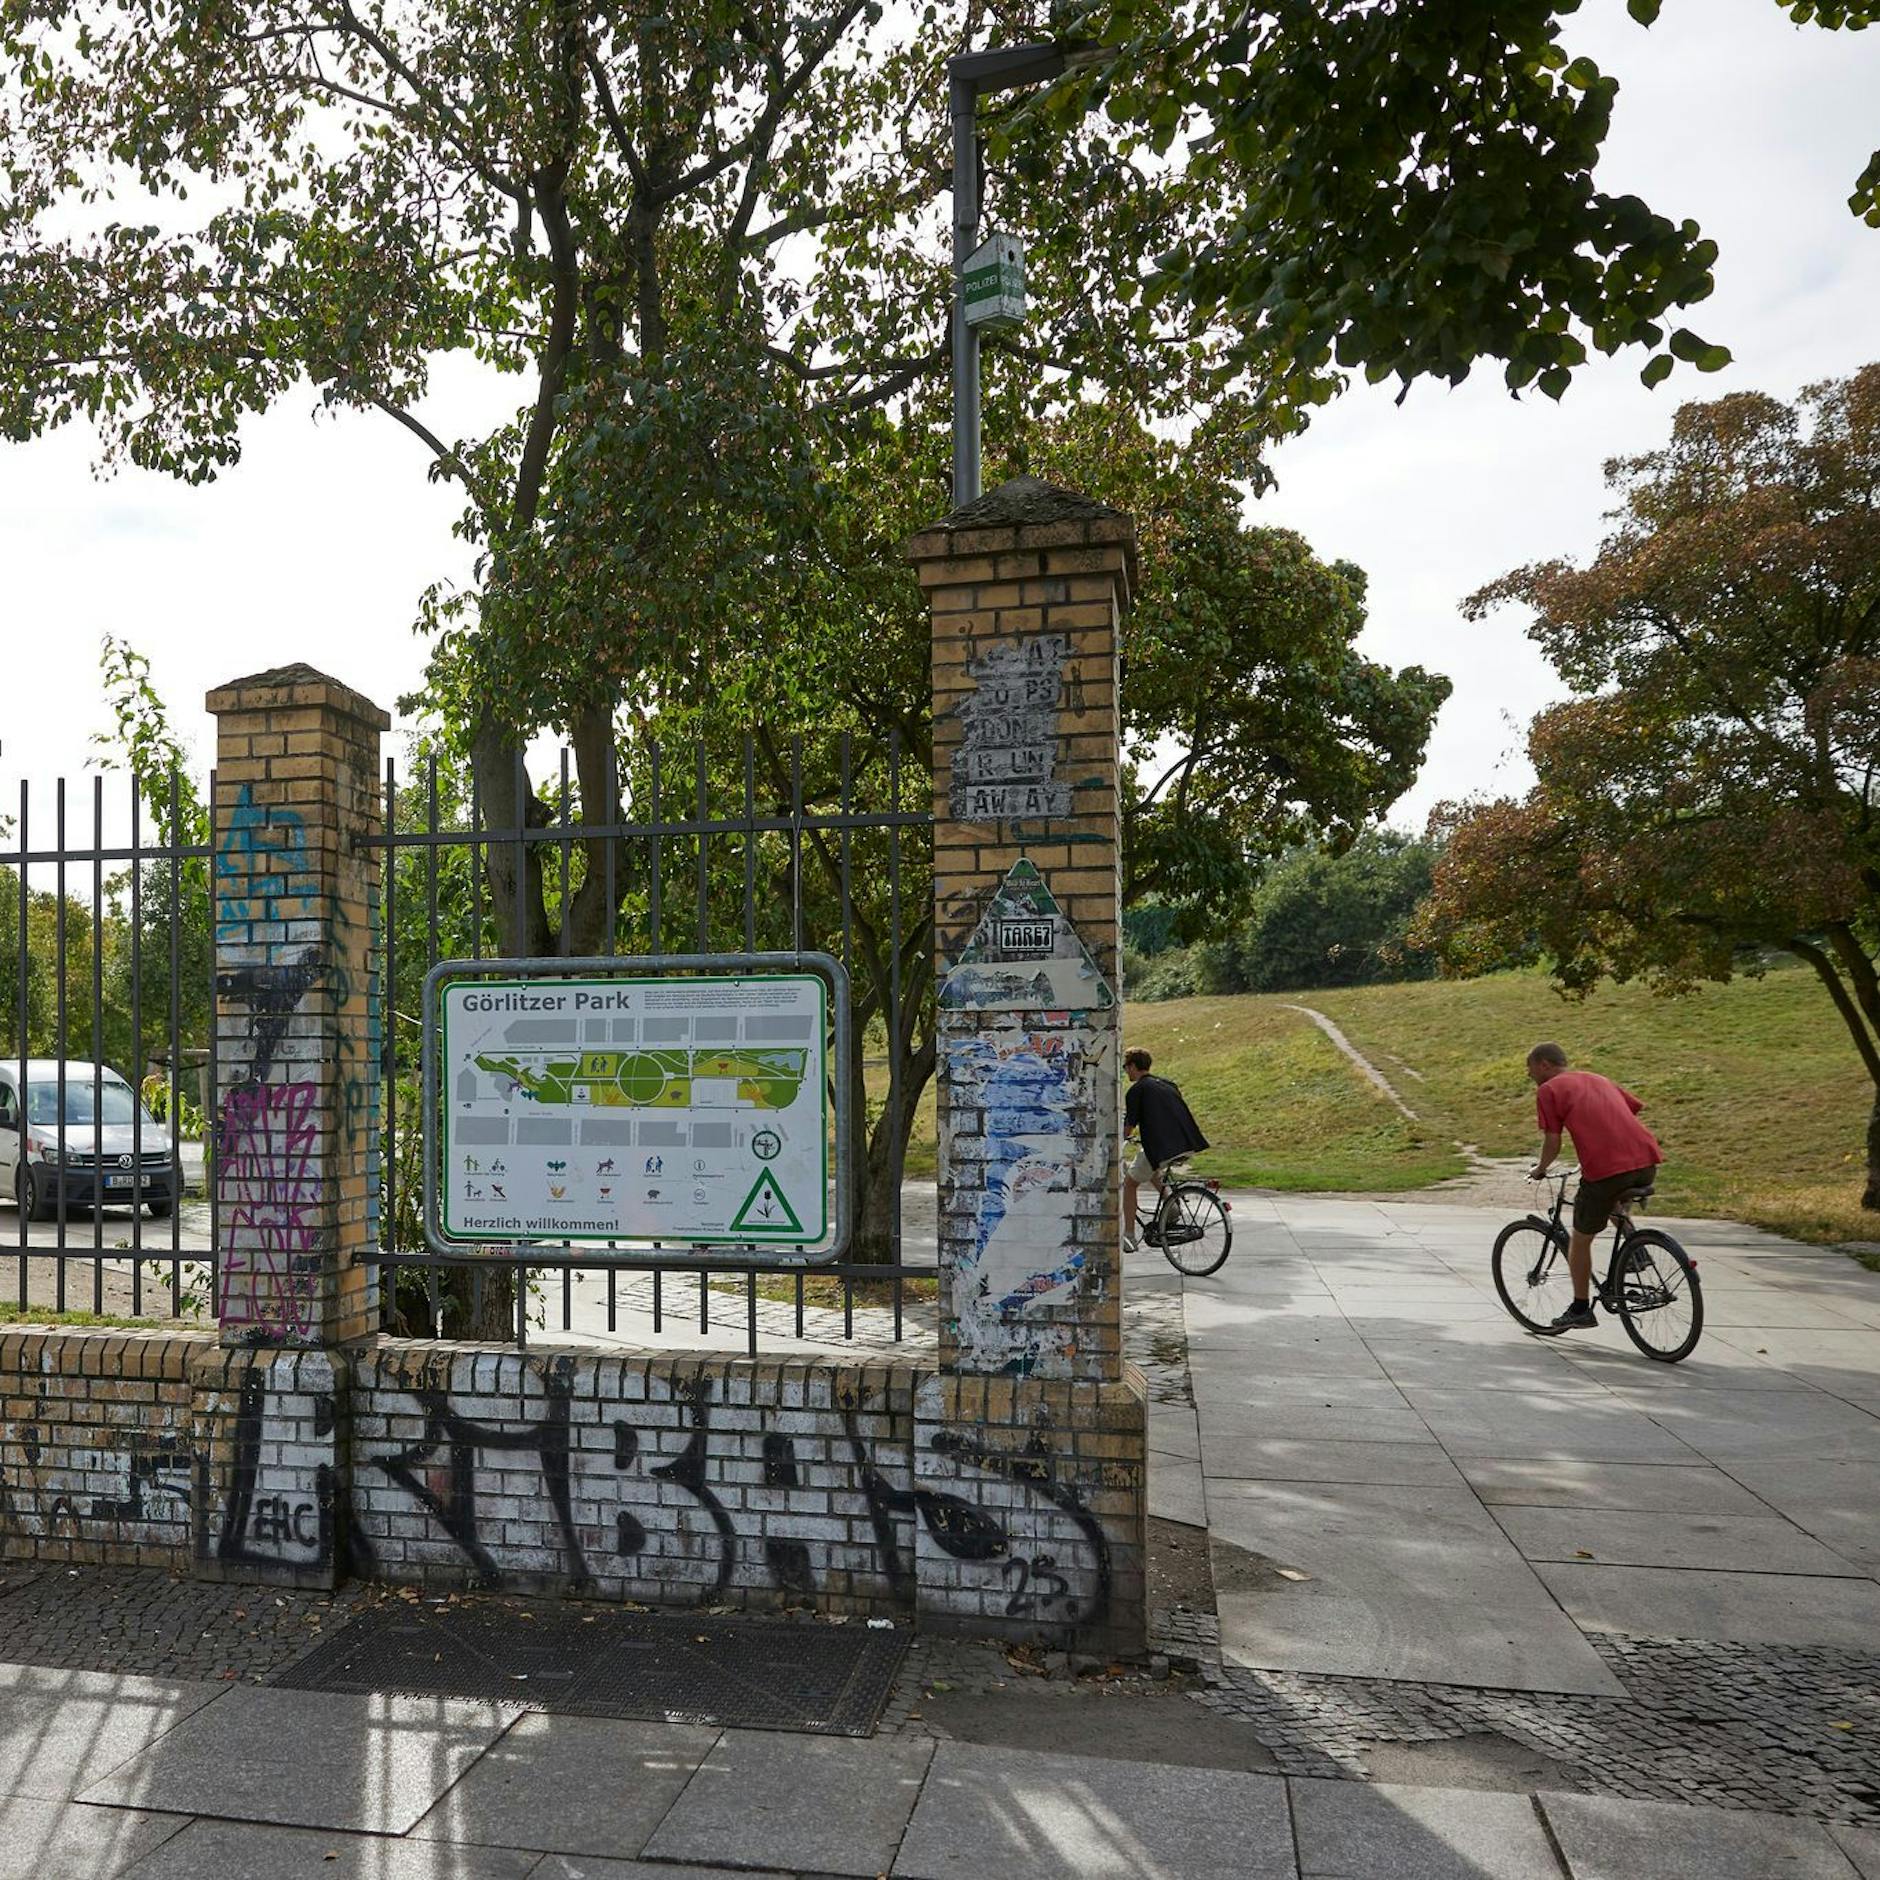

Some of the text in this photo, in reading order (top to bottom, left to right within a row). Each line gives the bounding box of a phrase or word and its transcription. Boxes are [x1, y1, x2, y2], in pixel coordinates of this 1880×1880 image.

[966, 274, 998, 293] POLIZEI
[974, 787, 1056, 813] AWAY
[463, 993, 567, 1012] Görlitzer
[575, 991, 630, 1010] Park
[464, 1217, 619, 1231] Herzlich willkommen!
